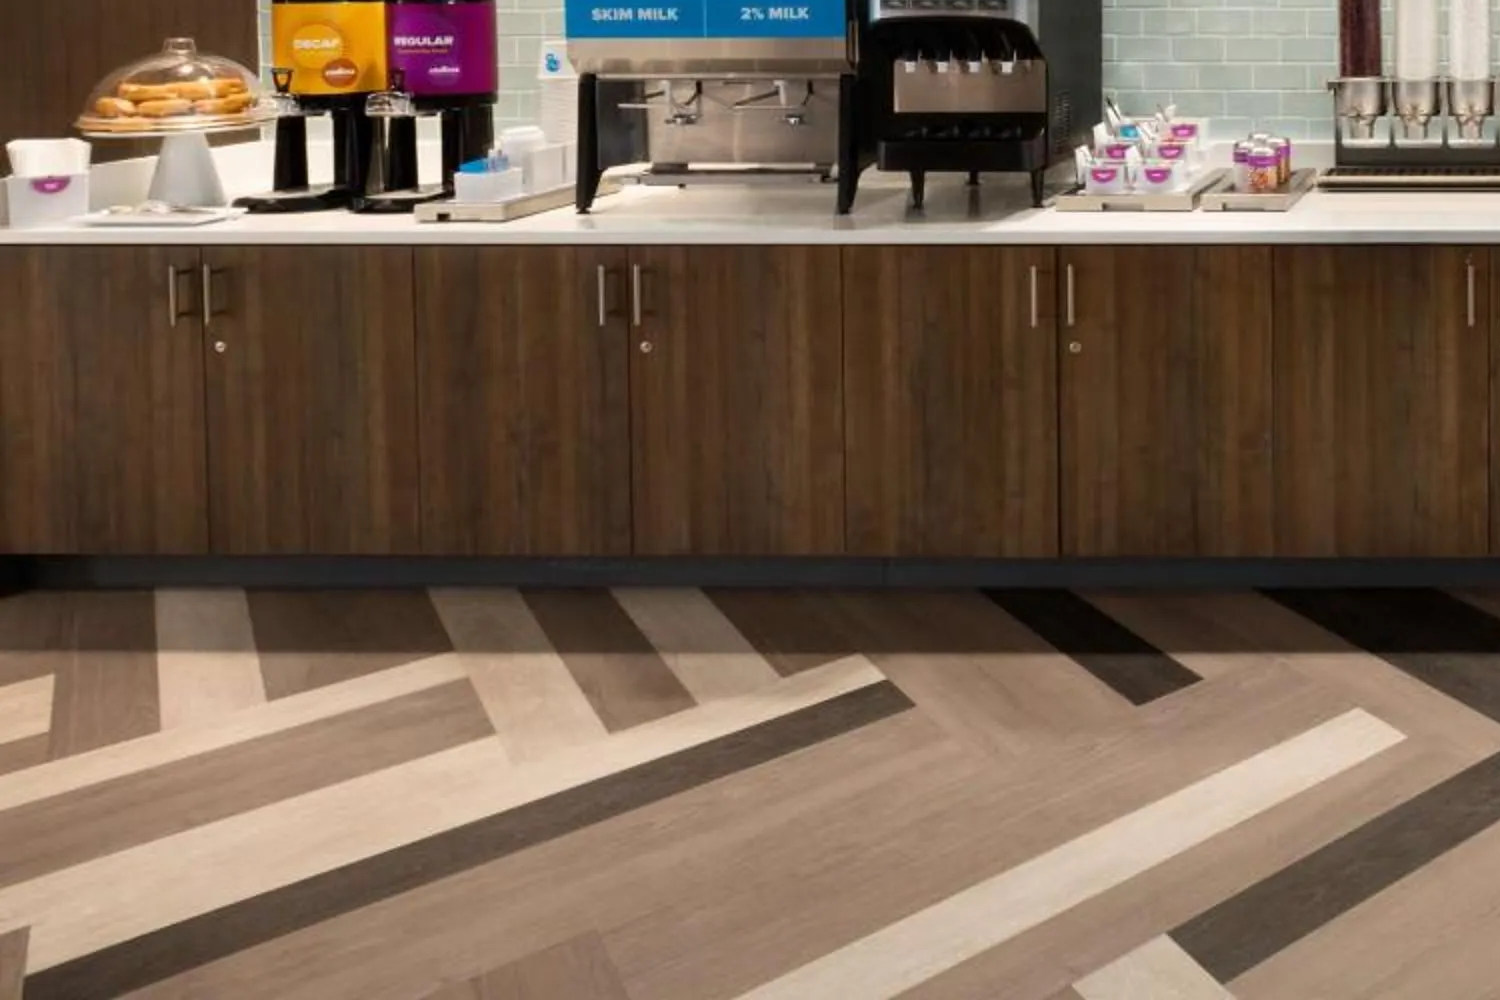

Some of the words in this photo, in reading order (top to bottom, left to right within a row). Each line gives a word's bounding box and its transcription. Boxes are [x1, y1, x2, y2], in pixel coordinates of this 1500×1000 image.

[591, 7, 632, 21] SKIM
[637, 7, 678, 21] MILK
[740, 7, 765, 20] 2%
[768, 7, 809, 20] MILK
[394, 35, 454, 46] REGULAR
